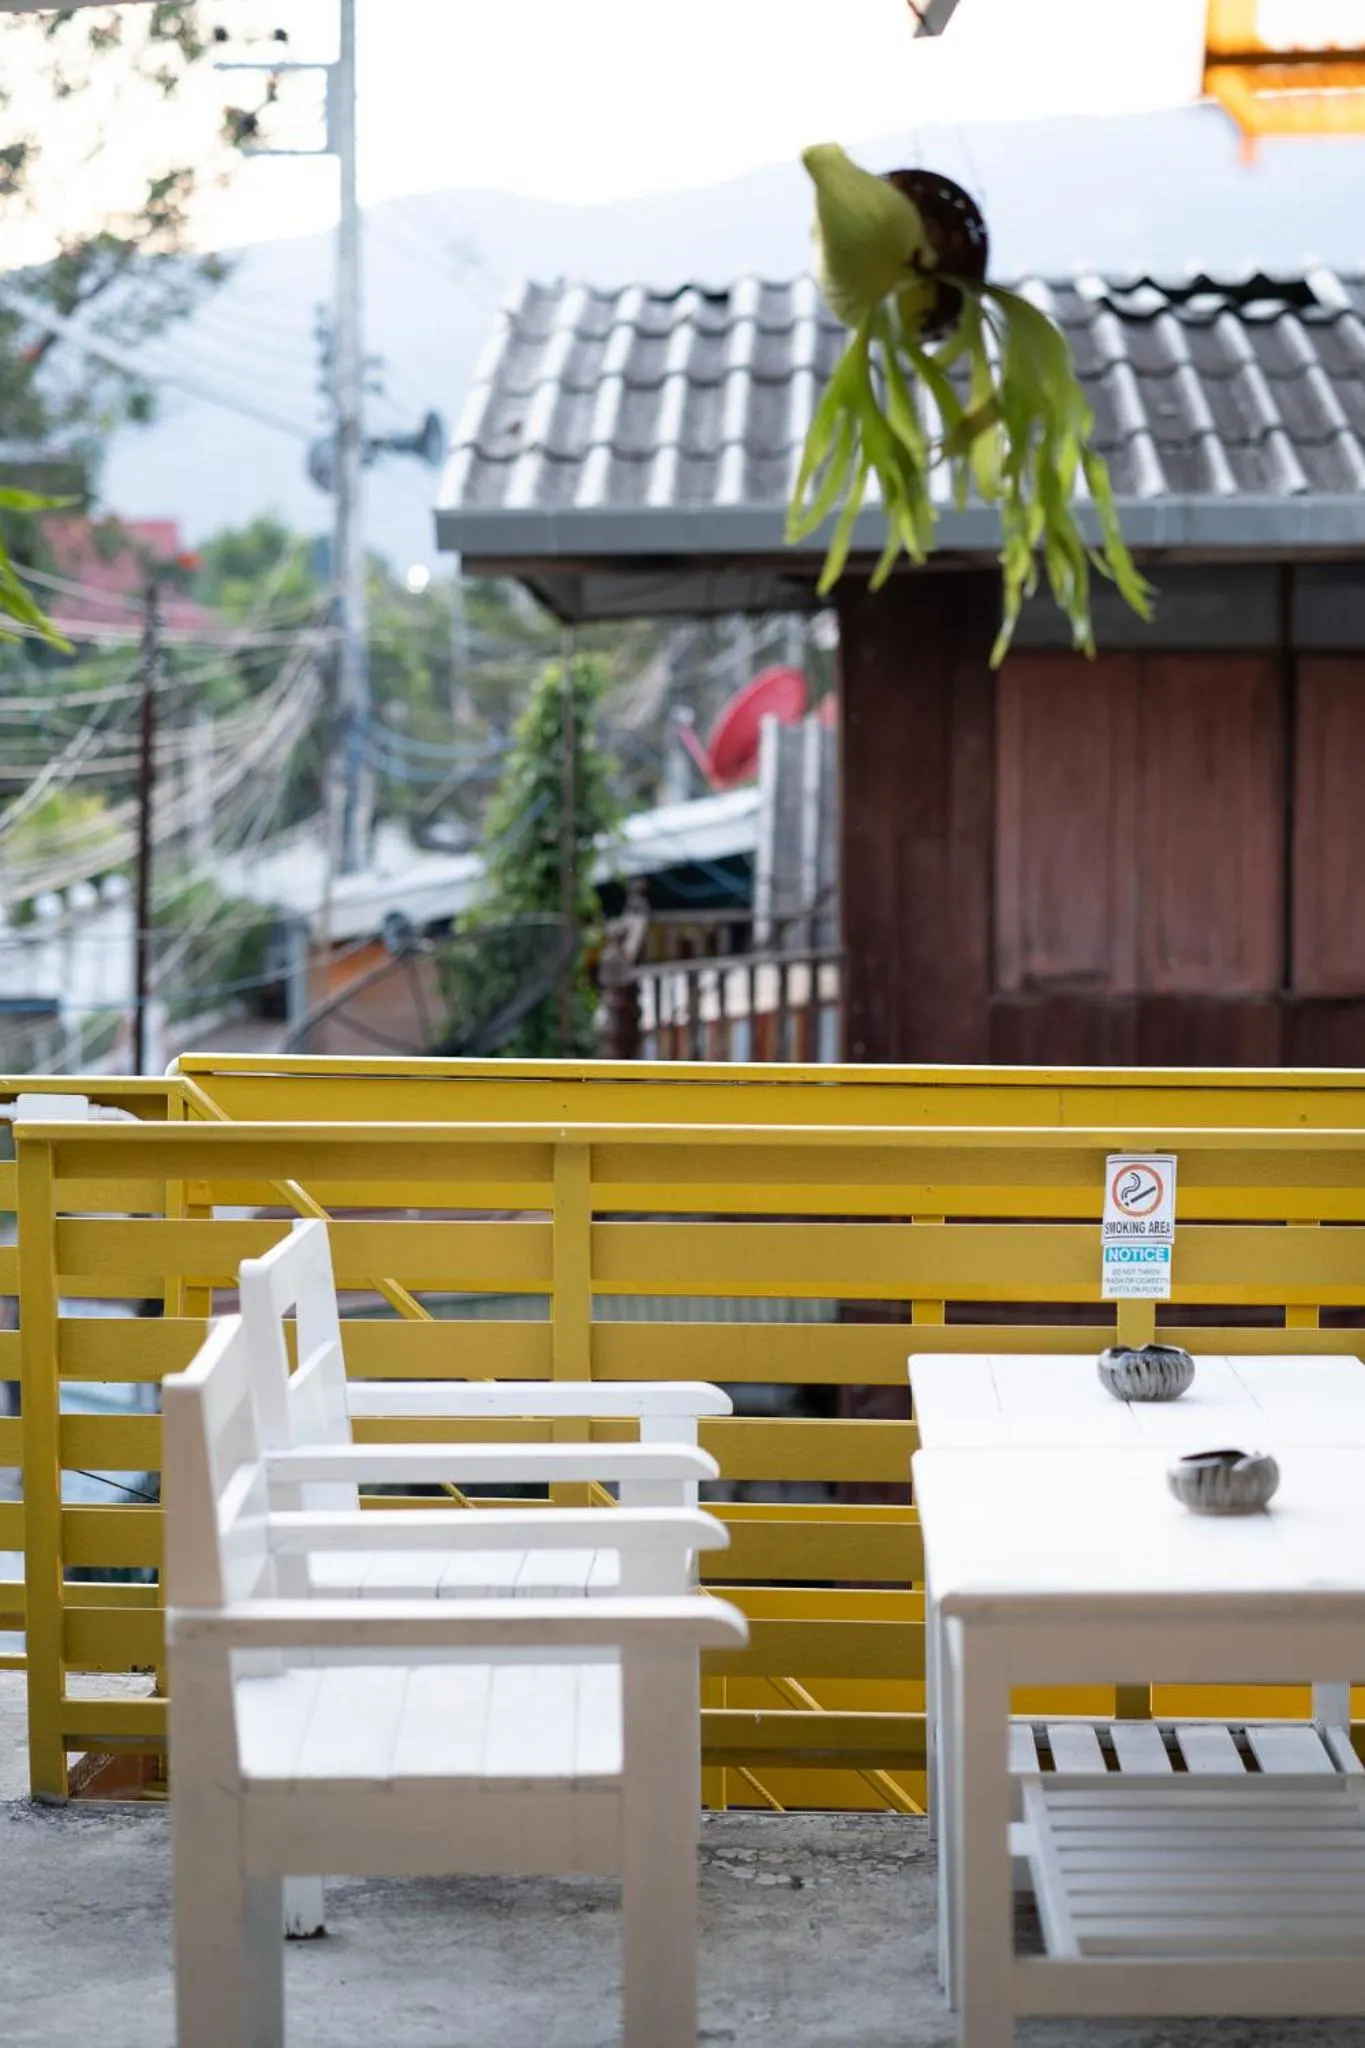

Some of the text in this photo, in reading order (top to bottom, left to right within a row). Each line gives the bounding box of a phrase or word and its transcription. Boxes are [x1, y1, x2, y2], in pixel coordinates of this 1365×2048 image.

[1105, 1221, 1170, 1234] SMOKING AREA
[1108, 1248, 1165, 1261] NOTICE
